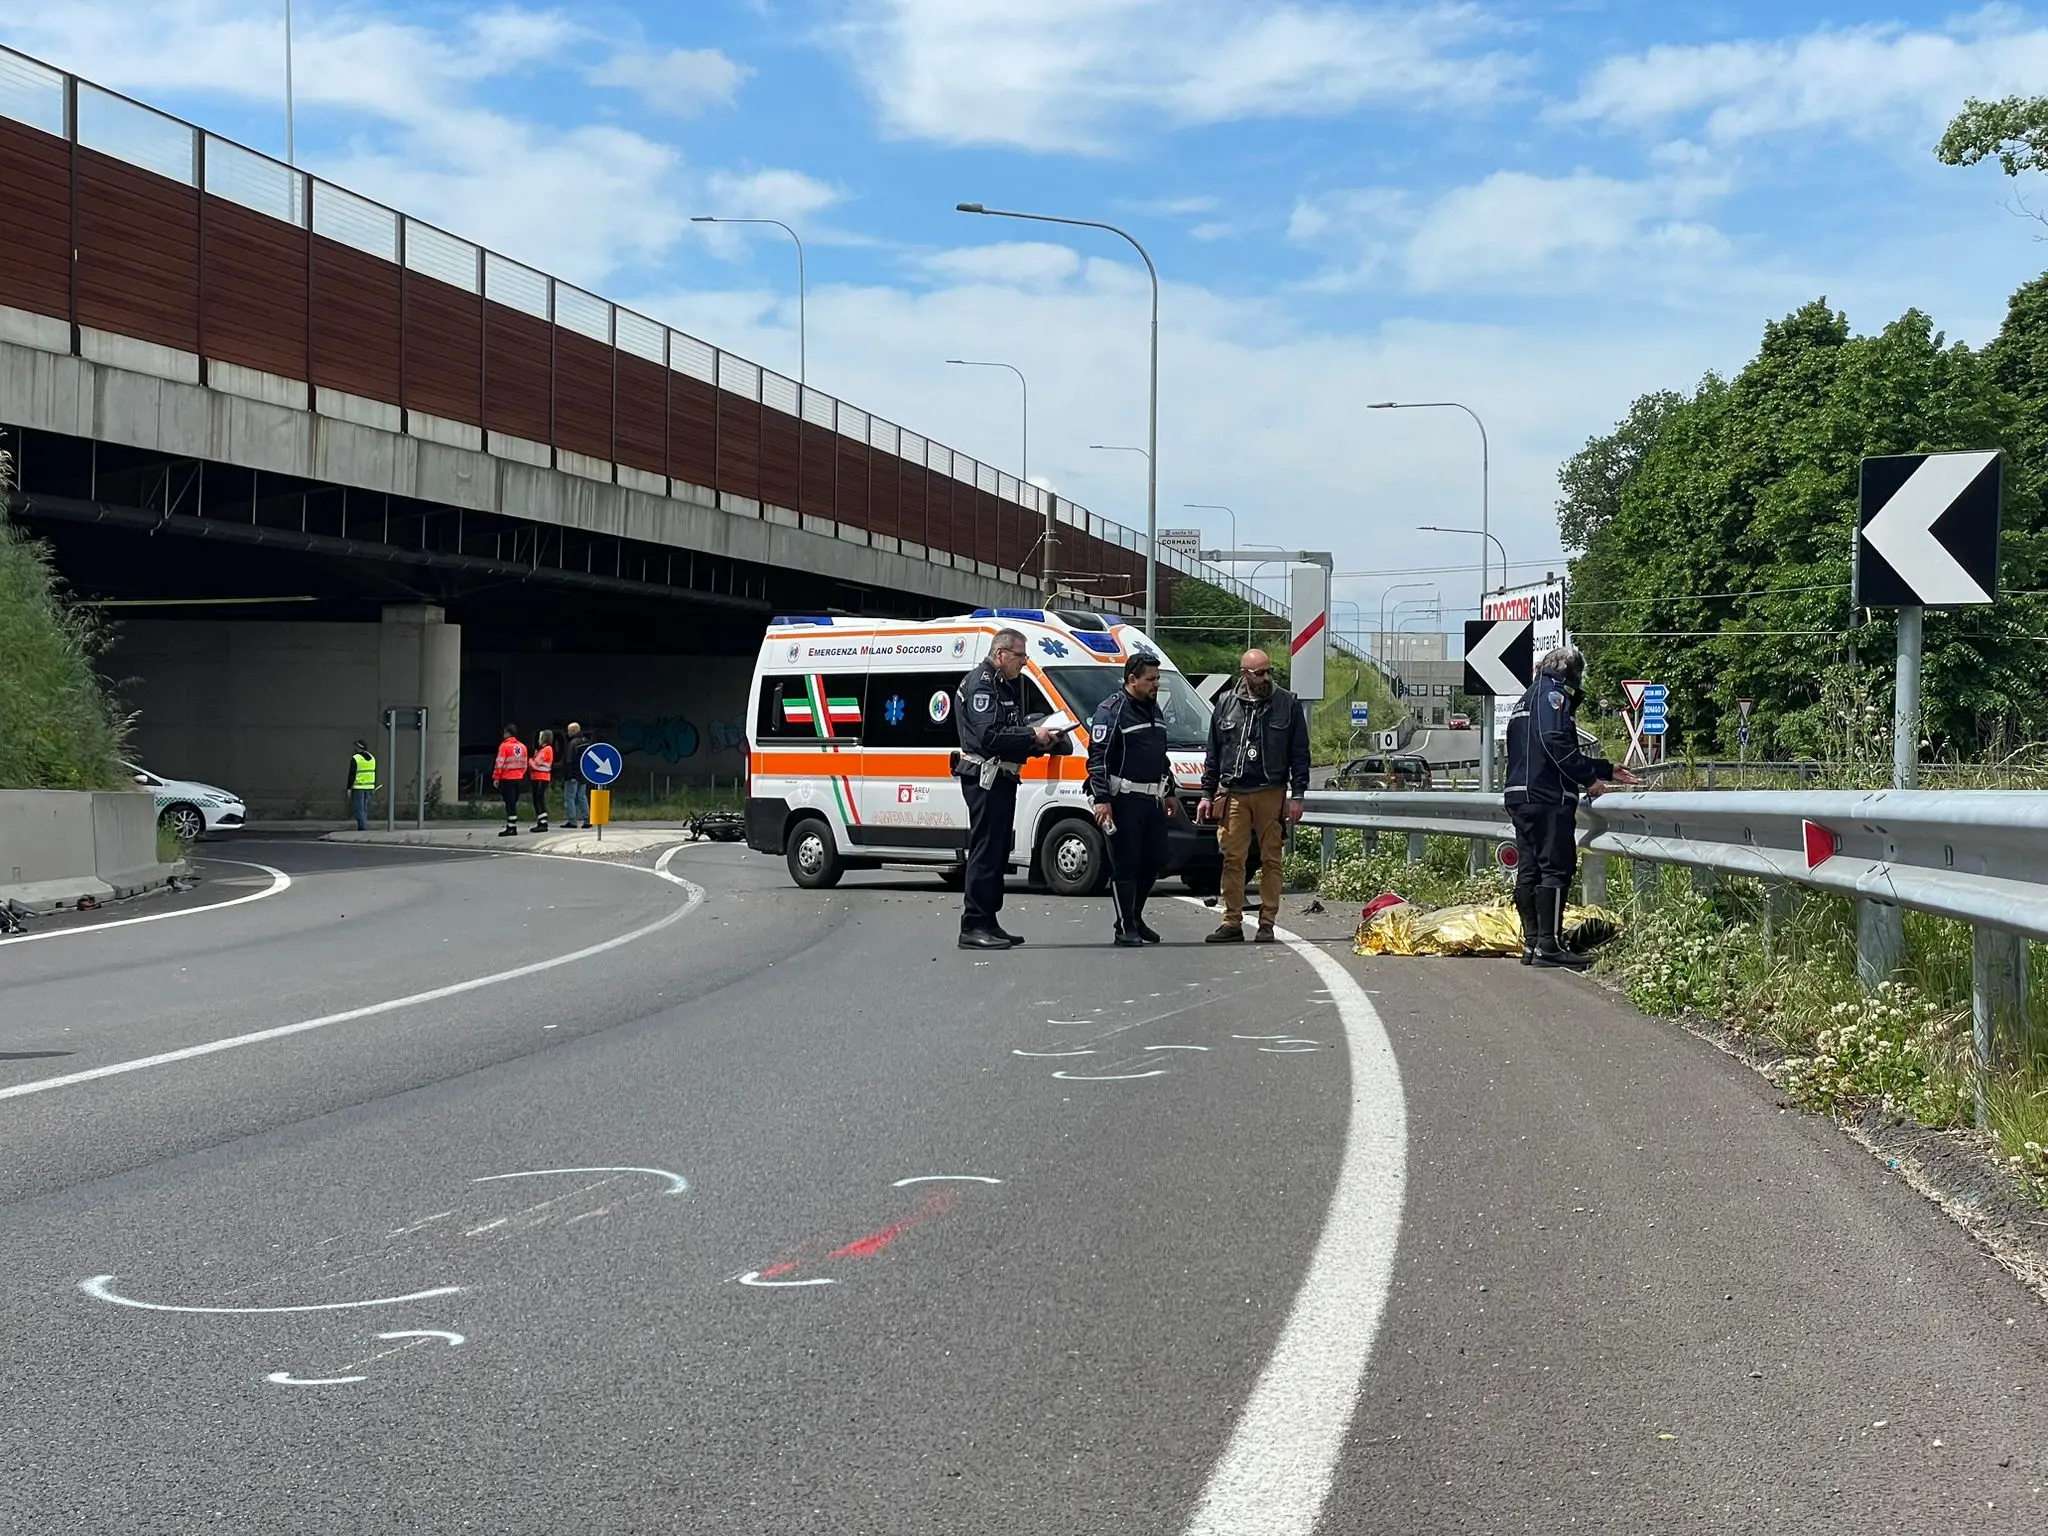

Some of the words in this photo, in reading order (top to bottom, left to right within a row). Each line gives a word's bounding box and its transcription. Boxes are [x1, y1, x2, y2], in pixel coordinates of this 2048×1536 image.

[1493, 591, 1561, 621] DOCTORGLASS
[1533, 629, 1560, 651] scurare?
[808, 647, 858, 657] EMERGENZA
[860, 646, 894, 655] MILANO
[895, 645, 943, 655] SOCCORSO
[1385, 733, 1393, 747] 0
[914, 786, 930, 794] AREU
[873, 811, 955, 826] AMBULANZA
